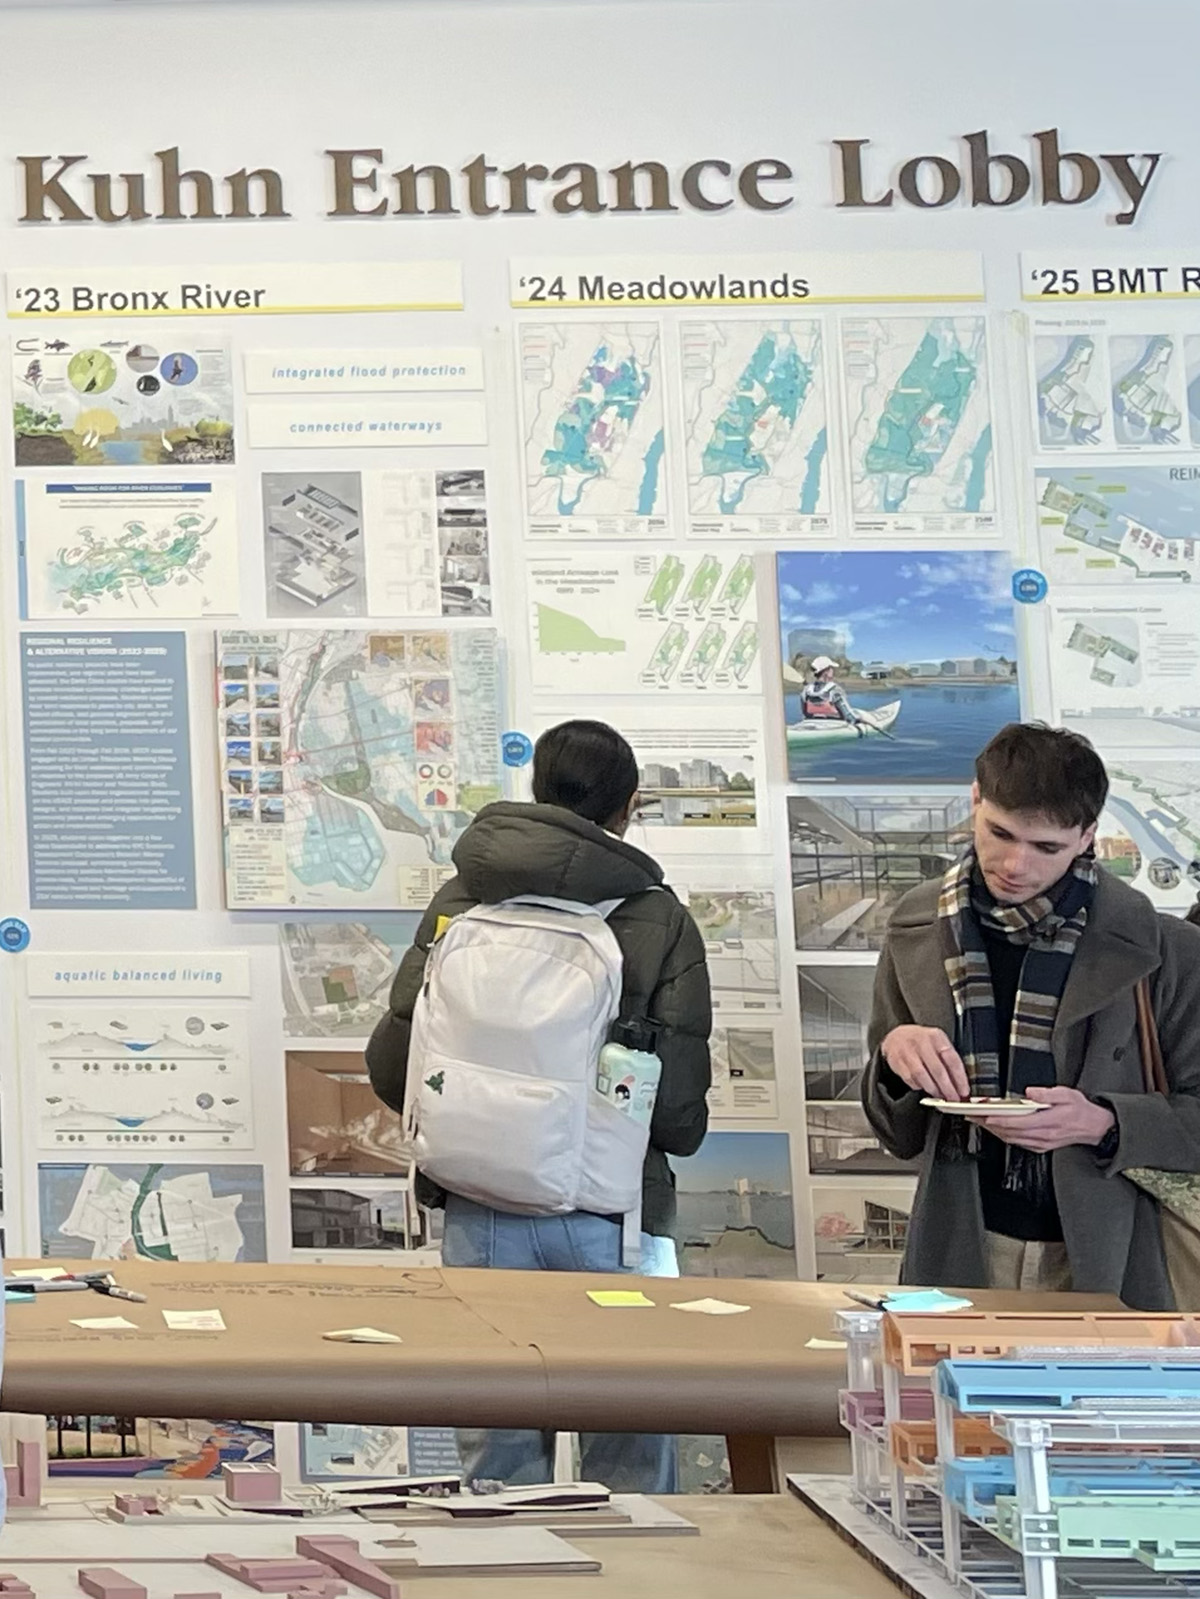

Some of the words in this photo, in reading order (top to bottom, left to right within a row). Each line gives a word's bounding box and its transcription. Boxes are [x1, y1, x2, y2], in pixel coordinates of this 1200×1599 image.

[16, 146, 292, 223] Kuhn
[325, 147, 793, 217] Entrance
[831, 127, 1164, 226] Lobby
[520, 276, 567, 302] ‘24
[579, 273, 810, 301] Meadowlands
[1031, 269, 1079, 296] ‘25
[1092, 267, 1169, 295] BMT
[15, 287, 60, 313] ‘23
[73, 286, 169, 312] Bronx
[181, 284, 266, 310] River
[272, 366, 345, 381] integrated
[350, 365, 387, 378] flood
[392, 365, 466, 379] protection
[289, 420, 363, 433] connected
[368, 421, 442, 434] waterways
[54, 969, 106, 983] aquatic
[111, 969, 176, 982] balanced
[182, 969, 223, 984] living
